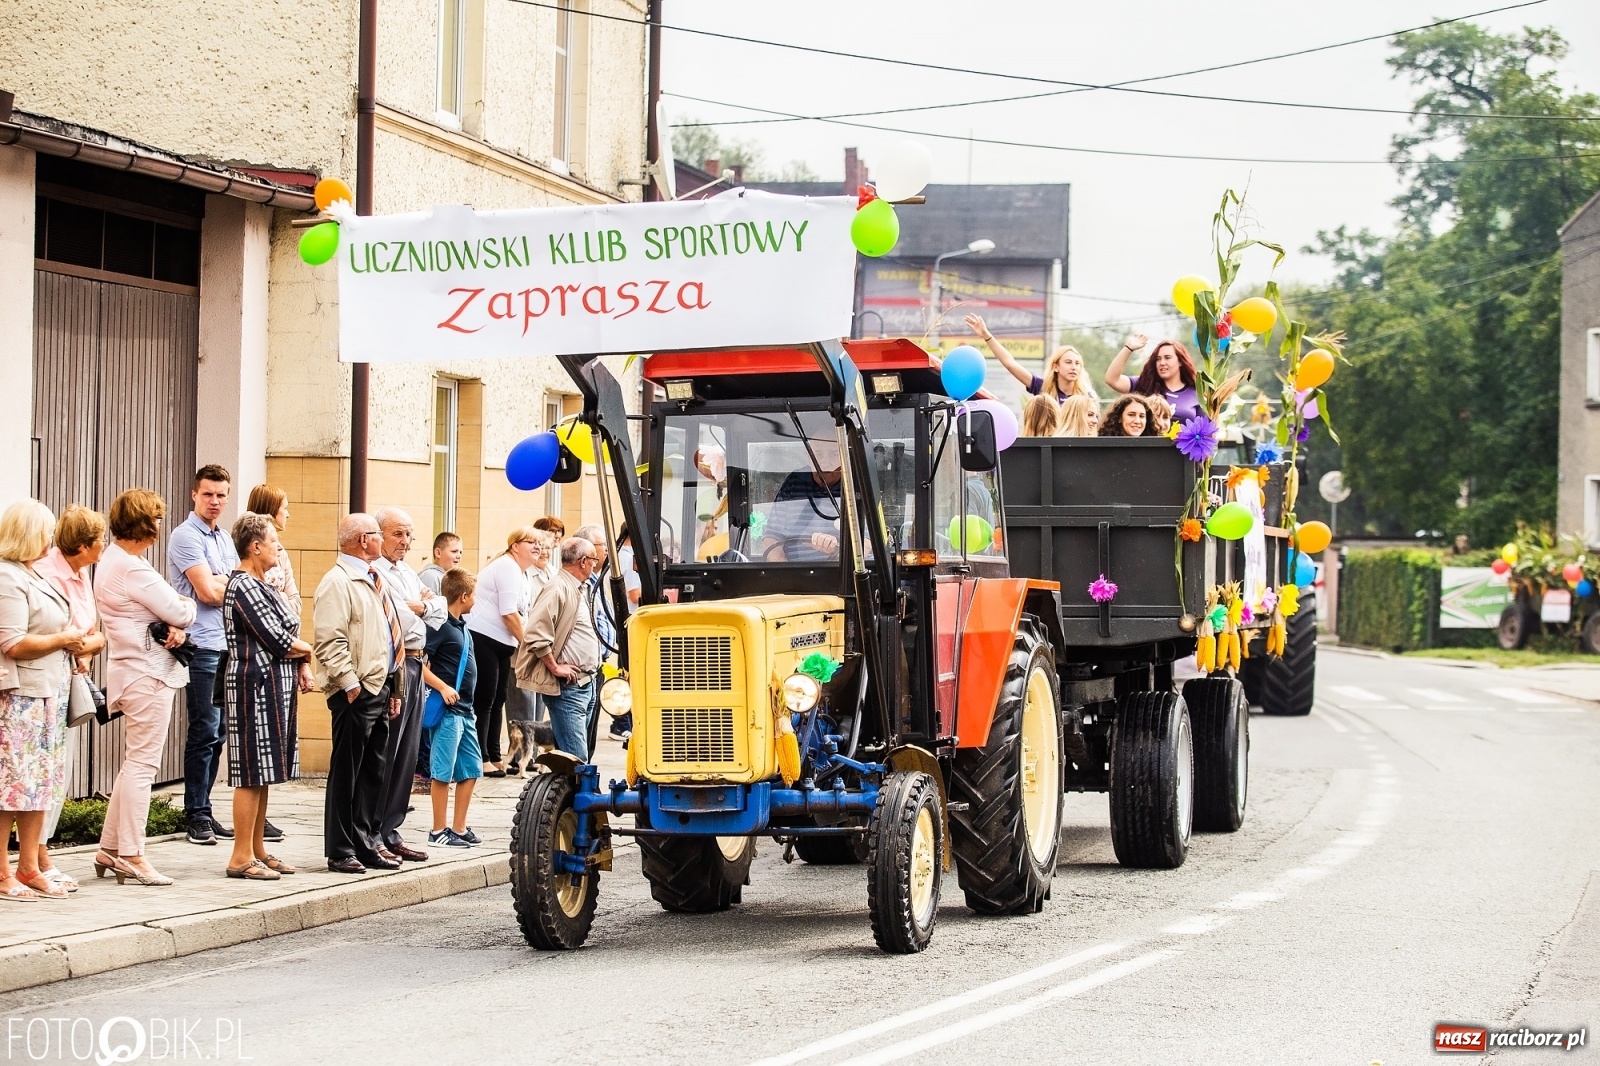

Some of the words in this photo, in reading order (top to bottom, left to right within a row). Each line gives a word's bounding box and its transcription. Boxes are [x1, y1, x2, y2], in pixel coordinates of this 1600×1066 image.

[350, 236, 530, 273] UCZNIOWSKI
[550, 230, 627, 264] KLUB
[645, 220, 809, 260] SPORTOWY
[437, 278, 712, 338] Zaprasza
